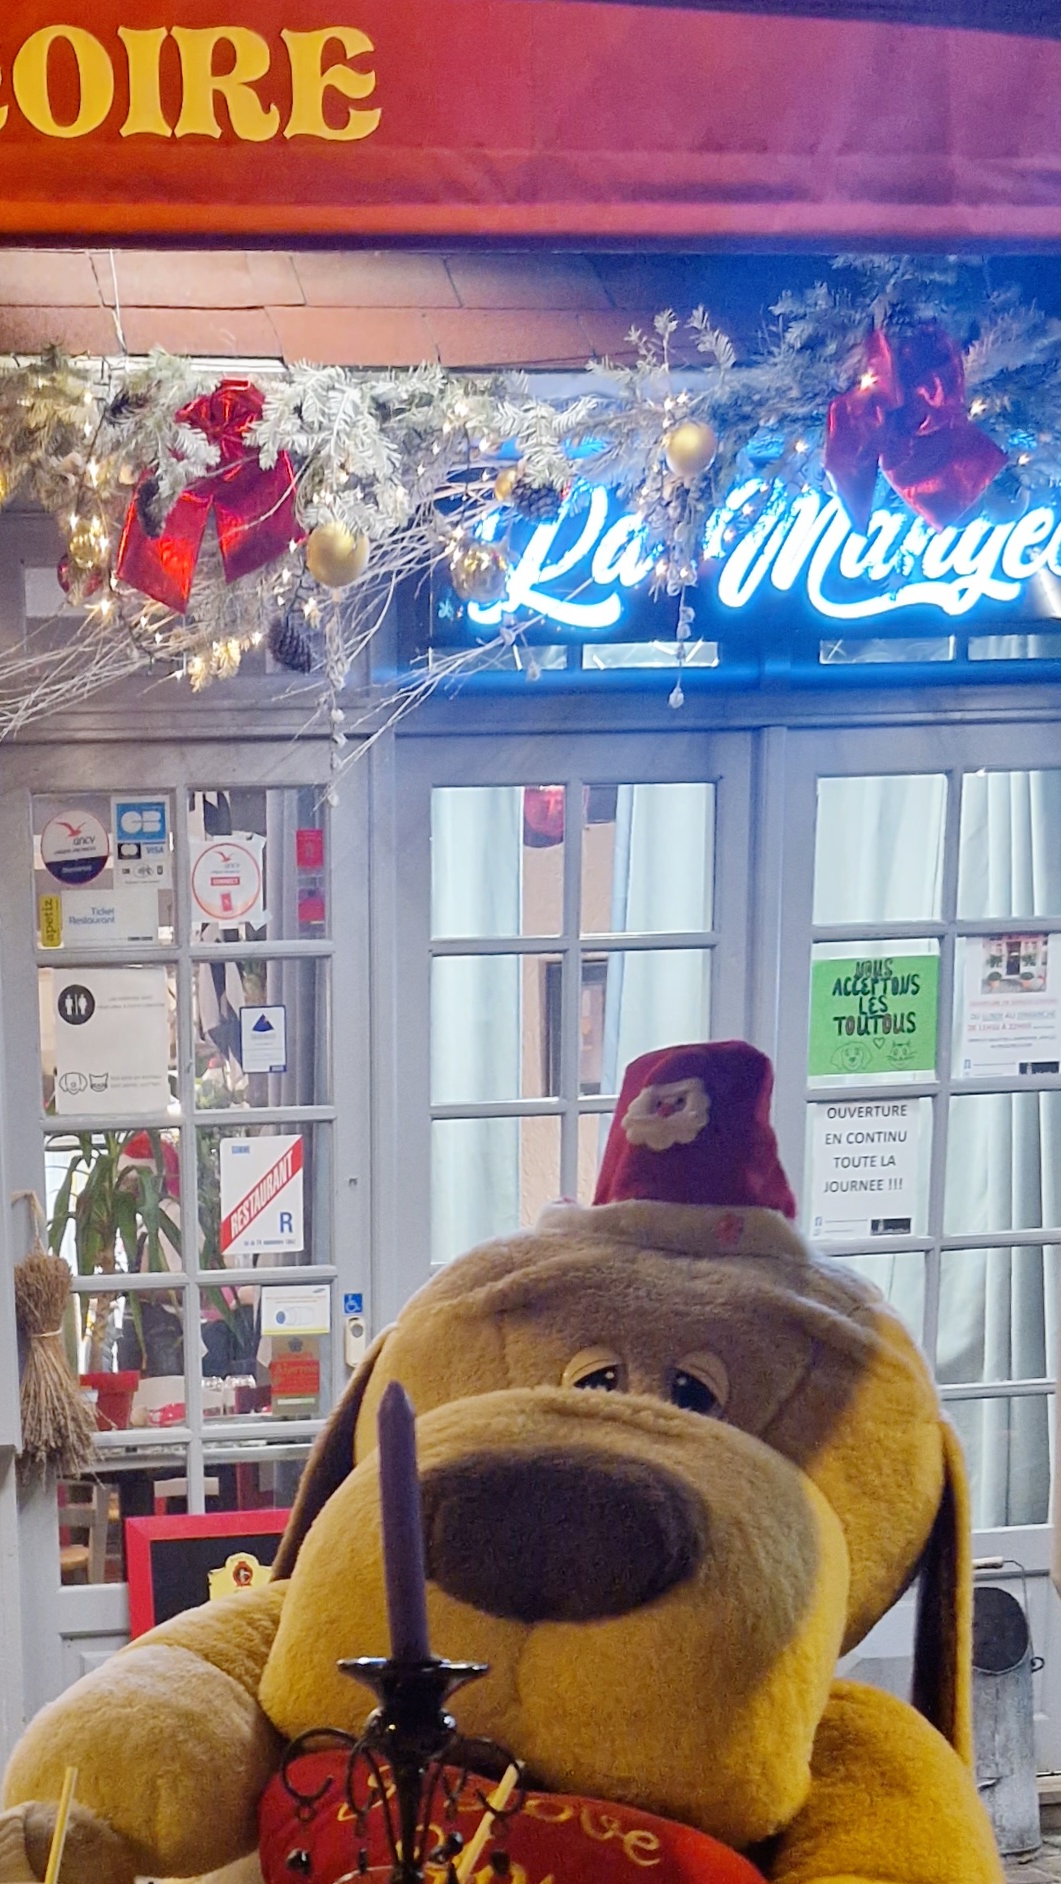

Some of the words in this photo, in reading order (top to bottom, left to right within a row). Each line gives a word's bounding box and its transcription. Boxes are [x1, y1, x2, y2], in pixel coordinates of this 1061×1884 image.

[91, 907, 115, 917] Ticket
[68, 915, 115, 925] Restaurant
[858, 994, 889, 1015] LES
[832, 1011, 917, 1037] TOUTOUS
[826, 1105, 908, 1119] OUVERTURE
[825, 1133, 843, 1145] EN
[846, 1131, 908, 1144] CONTINU
[833, 1156, 878, 1168] TOUTE
[880, 1155, 896, 1167] LA
[888, 1178, 903, 1190] !!!
[231, 1149, 294, 1241] RESTAURANT
[280, 1211, 293, 1234] R
